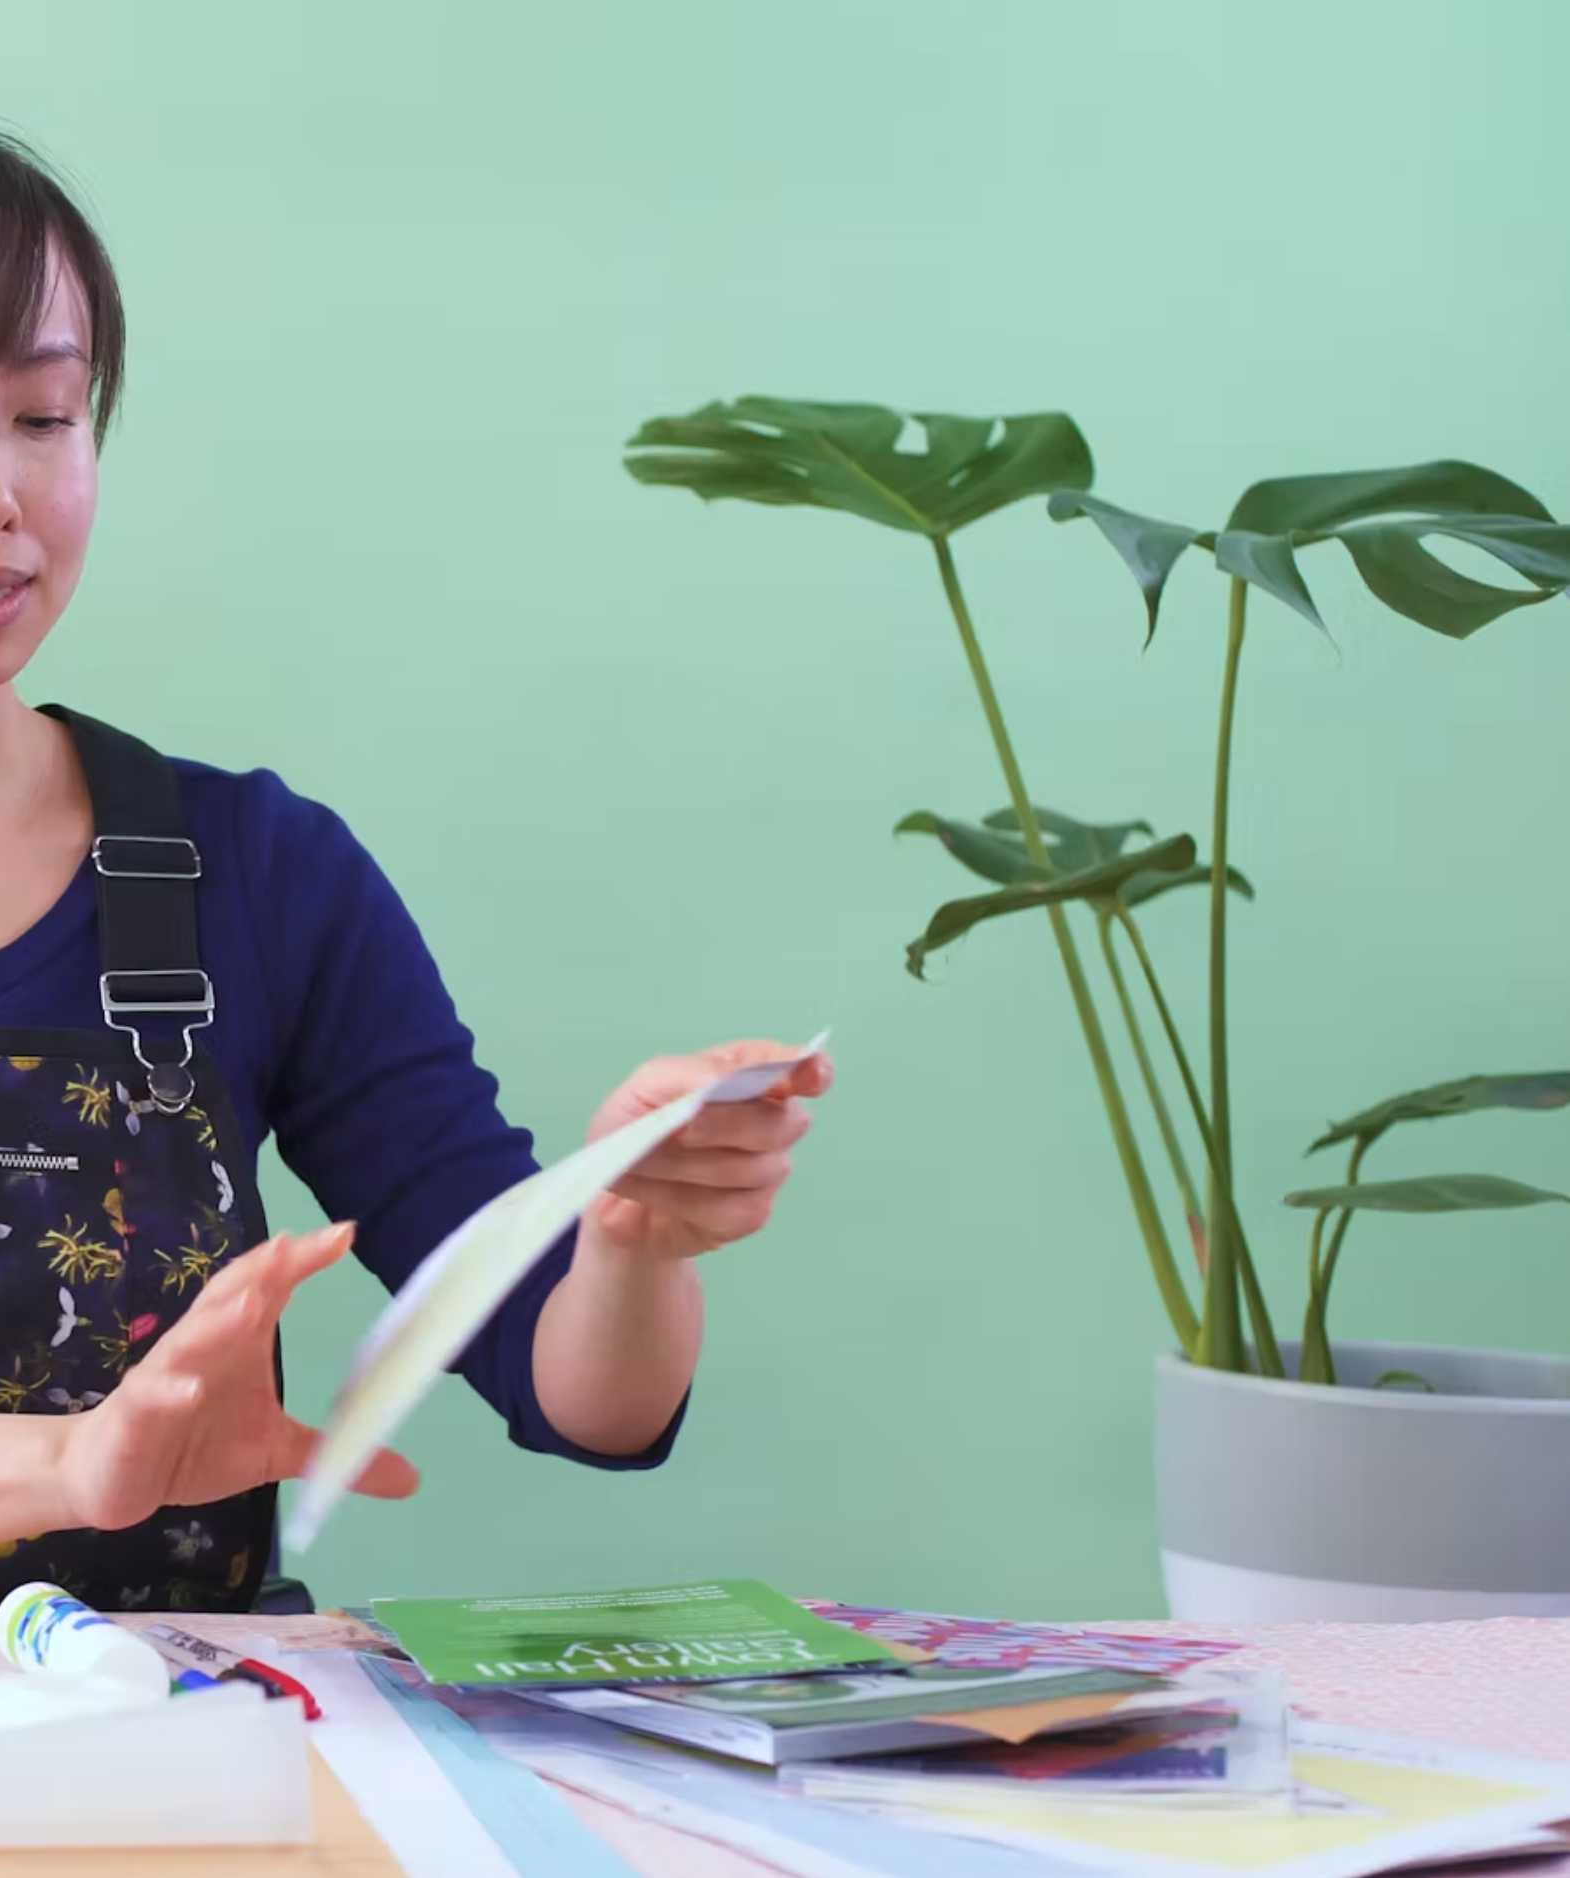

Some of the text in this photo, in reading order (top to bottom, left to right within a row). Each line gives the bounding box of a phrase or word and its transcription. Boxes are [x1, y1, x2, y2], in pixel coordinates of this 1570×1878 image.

[564, 1639, 806, 1658] Gallery
[475, 1659, 616, 1677] Hall
[627, 1651, 837, 1667] Town
